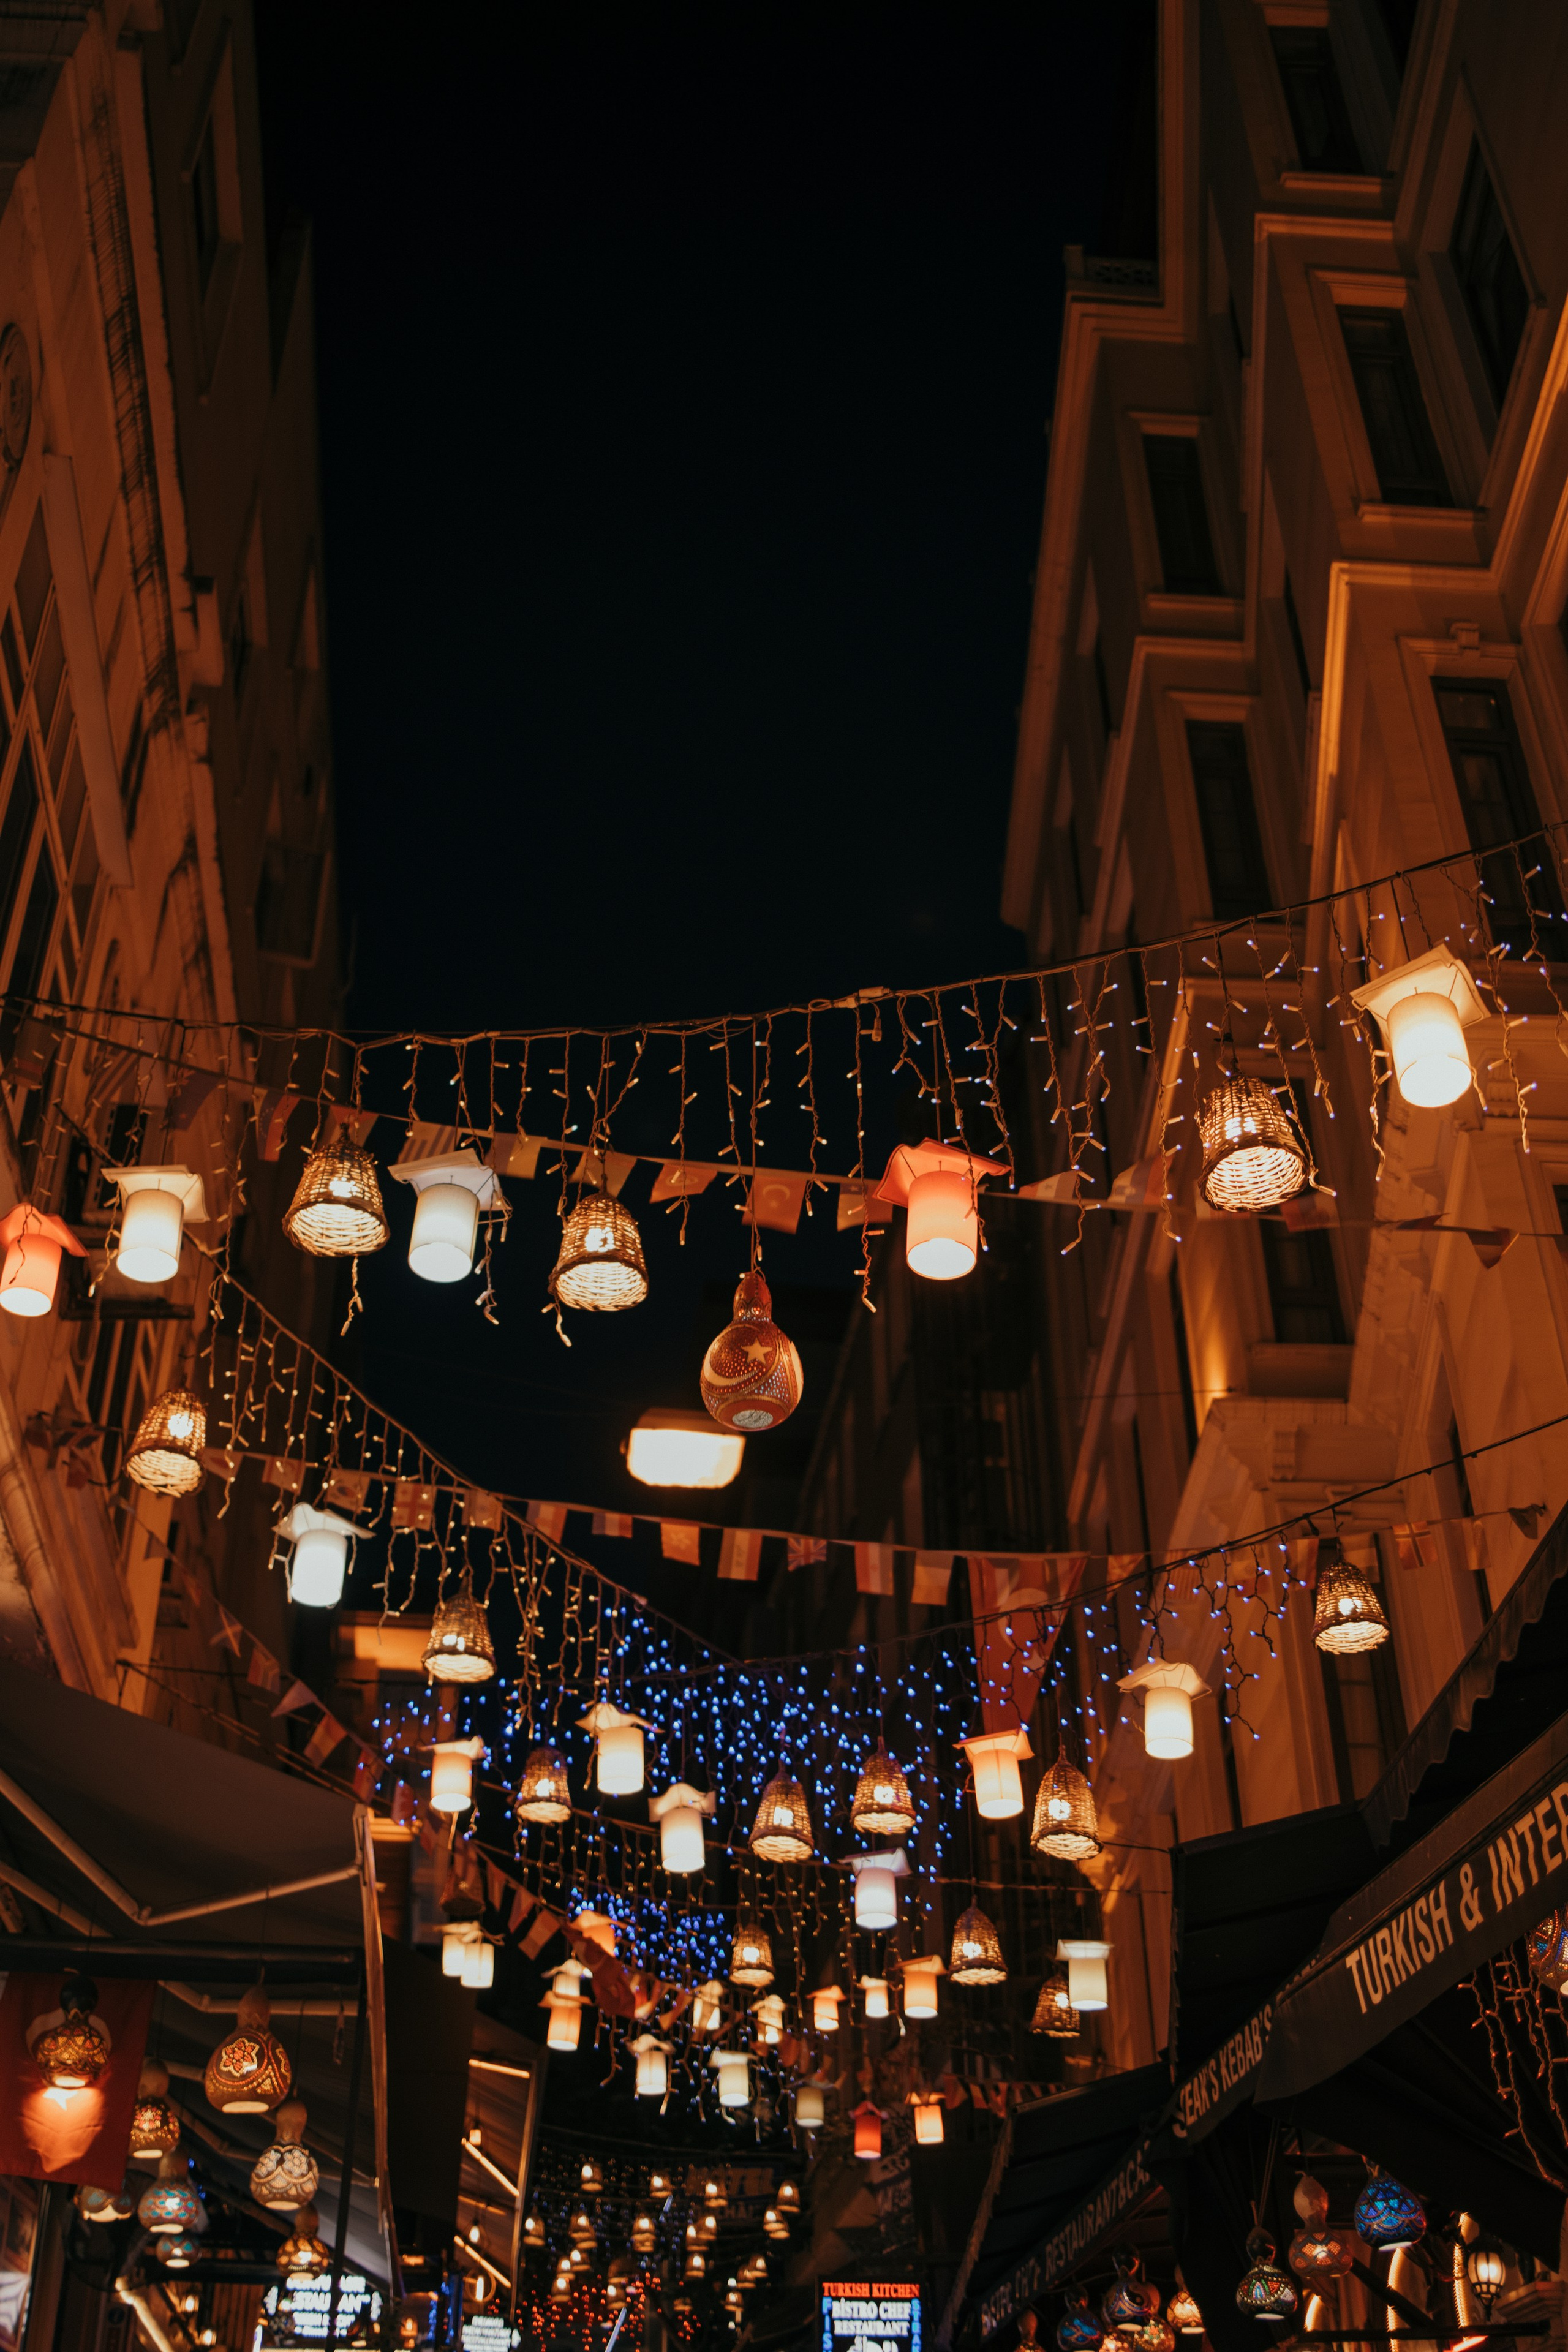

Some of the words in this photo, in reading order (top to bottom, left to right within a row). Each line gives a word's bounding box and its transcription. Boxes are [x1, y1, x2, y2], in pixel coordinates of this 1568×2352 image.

[1344, 1879, 1454, 2015] TURKISH
[1458, 1861, 1485, 1932] &
[822, 2282, 870, 2297] TURKISH
[872, 2283, 919, 2297] KITCHEN
[878, 2302, 911, 2320] CHEF
[822, 2297, 833, 2352] FIS
[834, 2320, 910, 2336] RESTAURANT
